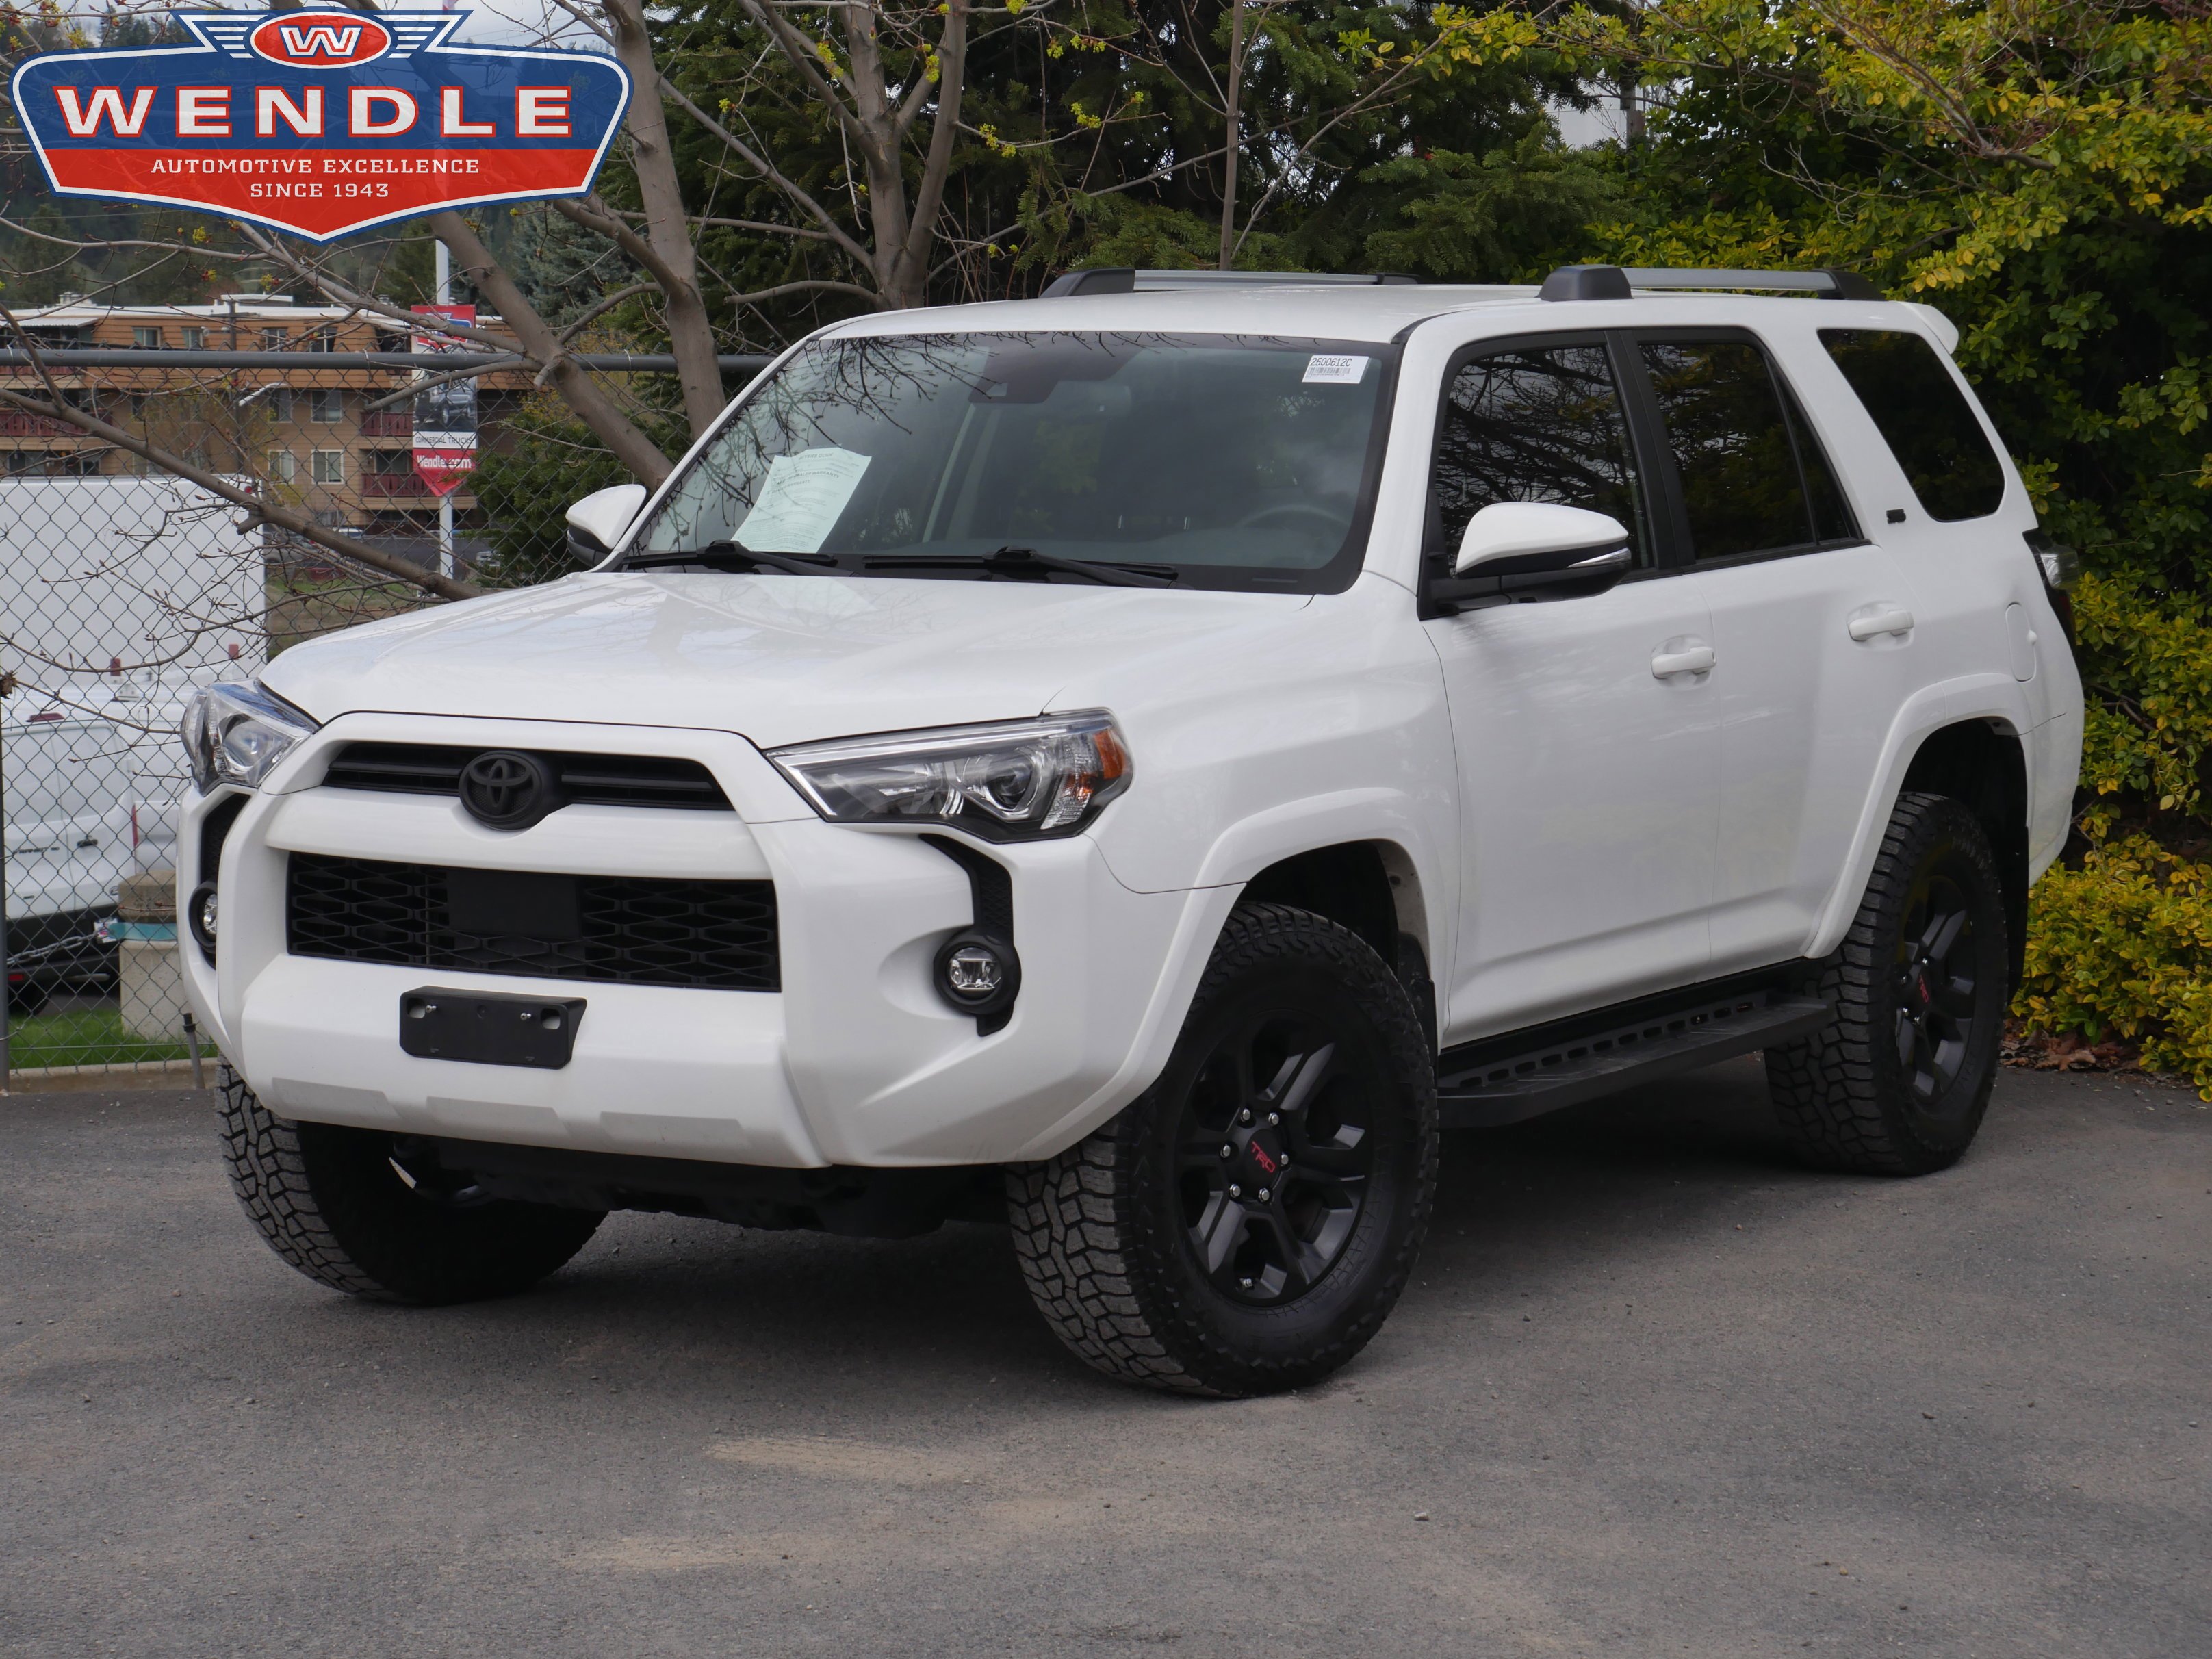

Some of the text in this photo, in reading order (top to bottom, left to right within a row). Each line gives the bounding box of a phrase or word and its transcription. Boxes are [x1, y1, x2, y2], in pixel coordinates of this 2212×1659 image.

[1310, 357, 1352, 367] 2500612C
[416, 454, 472, 469] Wendle.com
[1251, 1141, 1276, 1174] TRD
